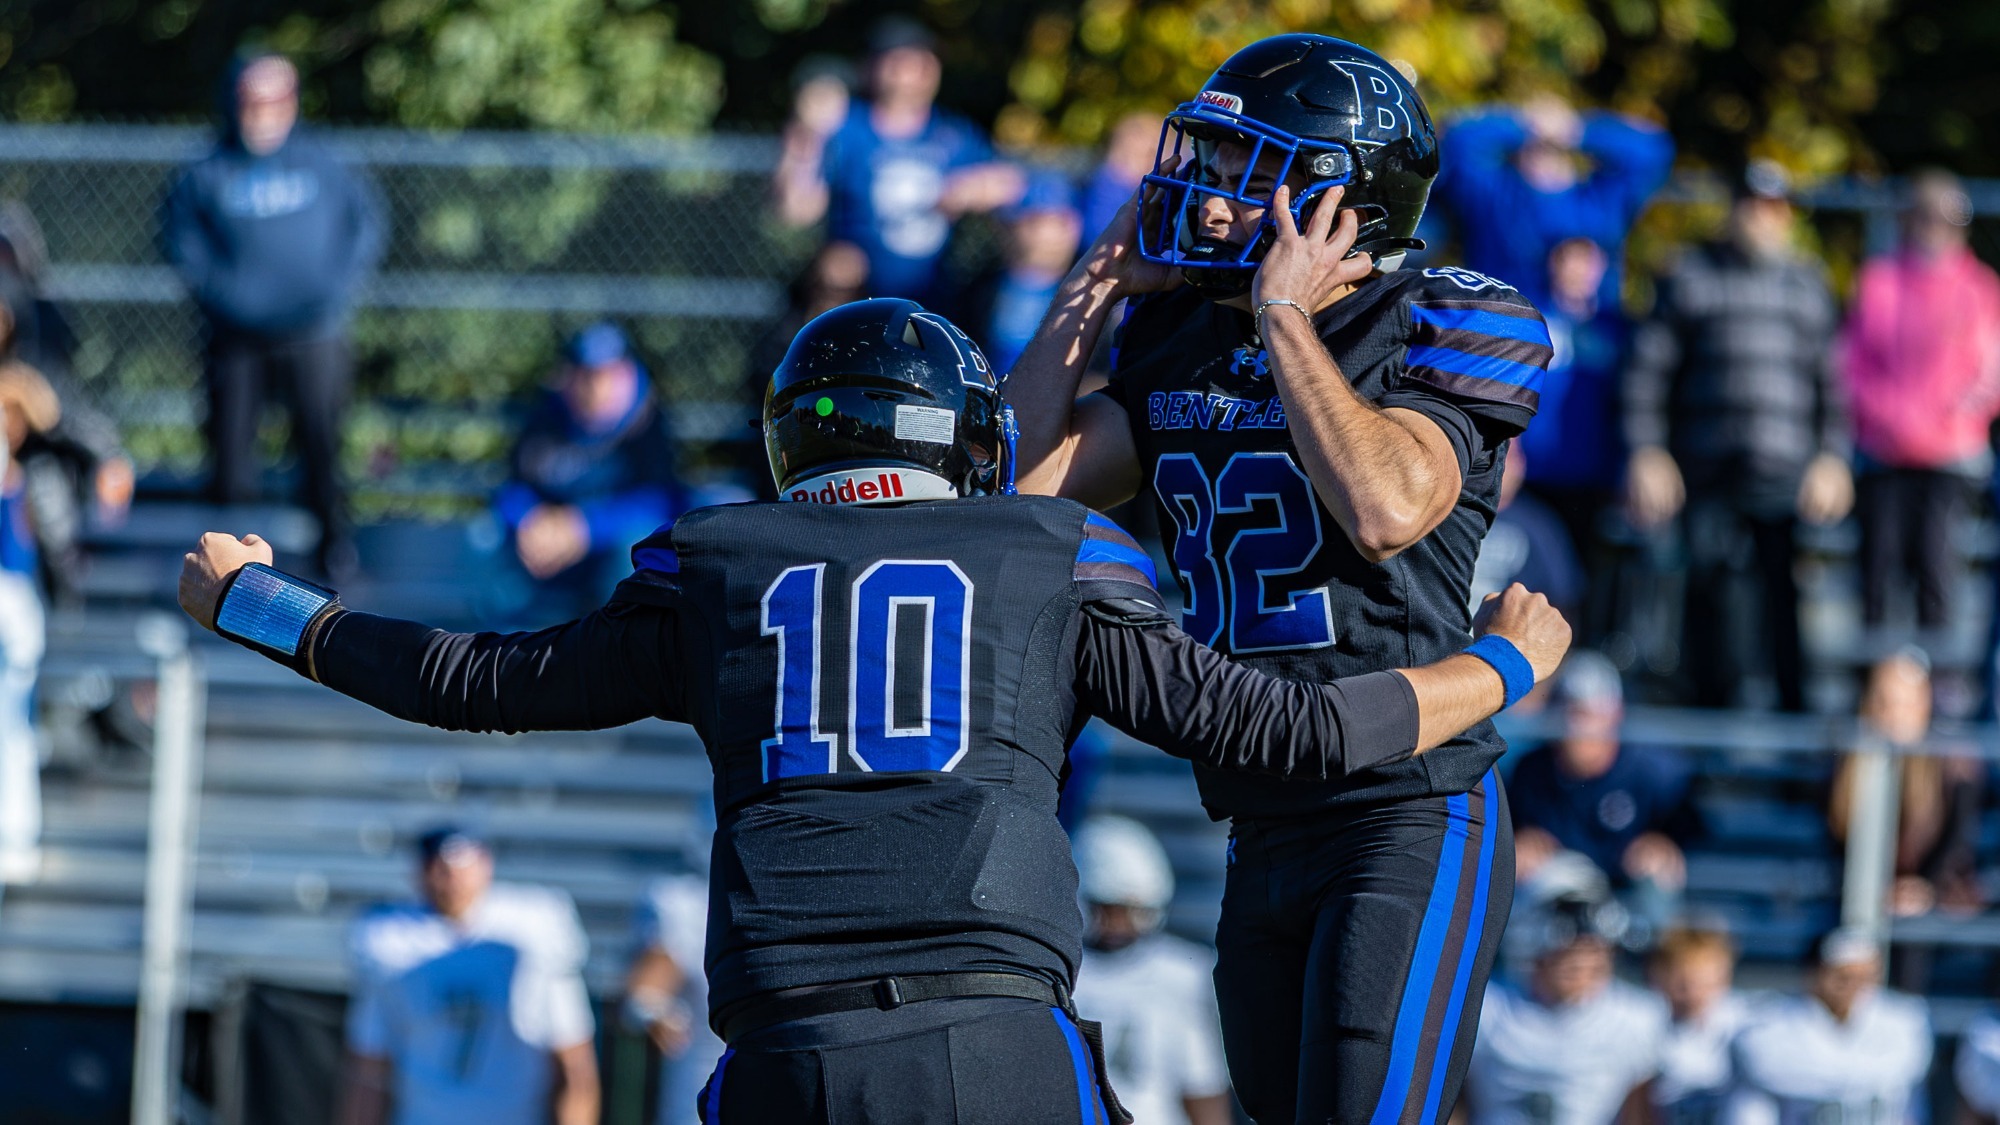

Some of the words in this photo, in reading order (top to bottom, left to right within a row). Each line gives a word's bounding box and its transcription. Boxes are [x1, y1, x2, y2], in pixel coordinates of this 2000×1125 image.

[1328, 60, 1412, 146] B
[910, 312, 998, 391] B
[1148, 391, 1287, 432] BENTLE
[1153, 452, 1337, 655] 82
[760, 559, 975, 784] 10
